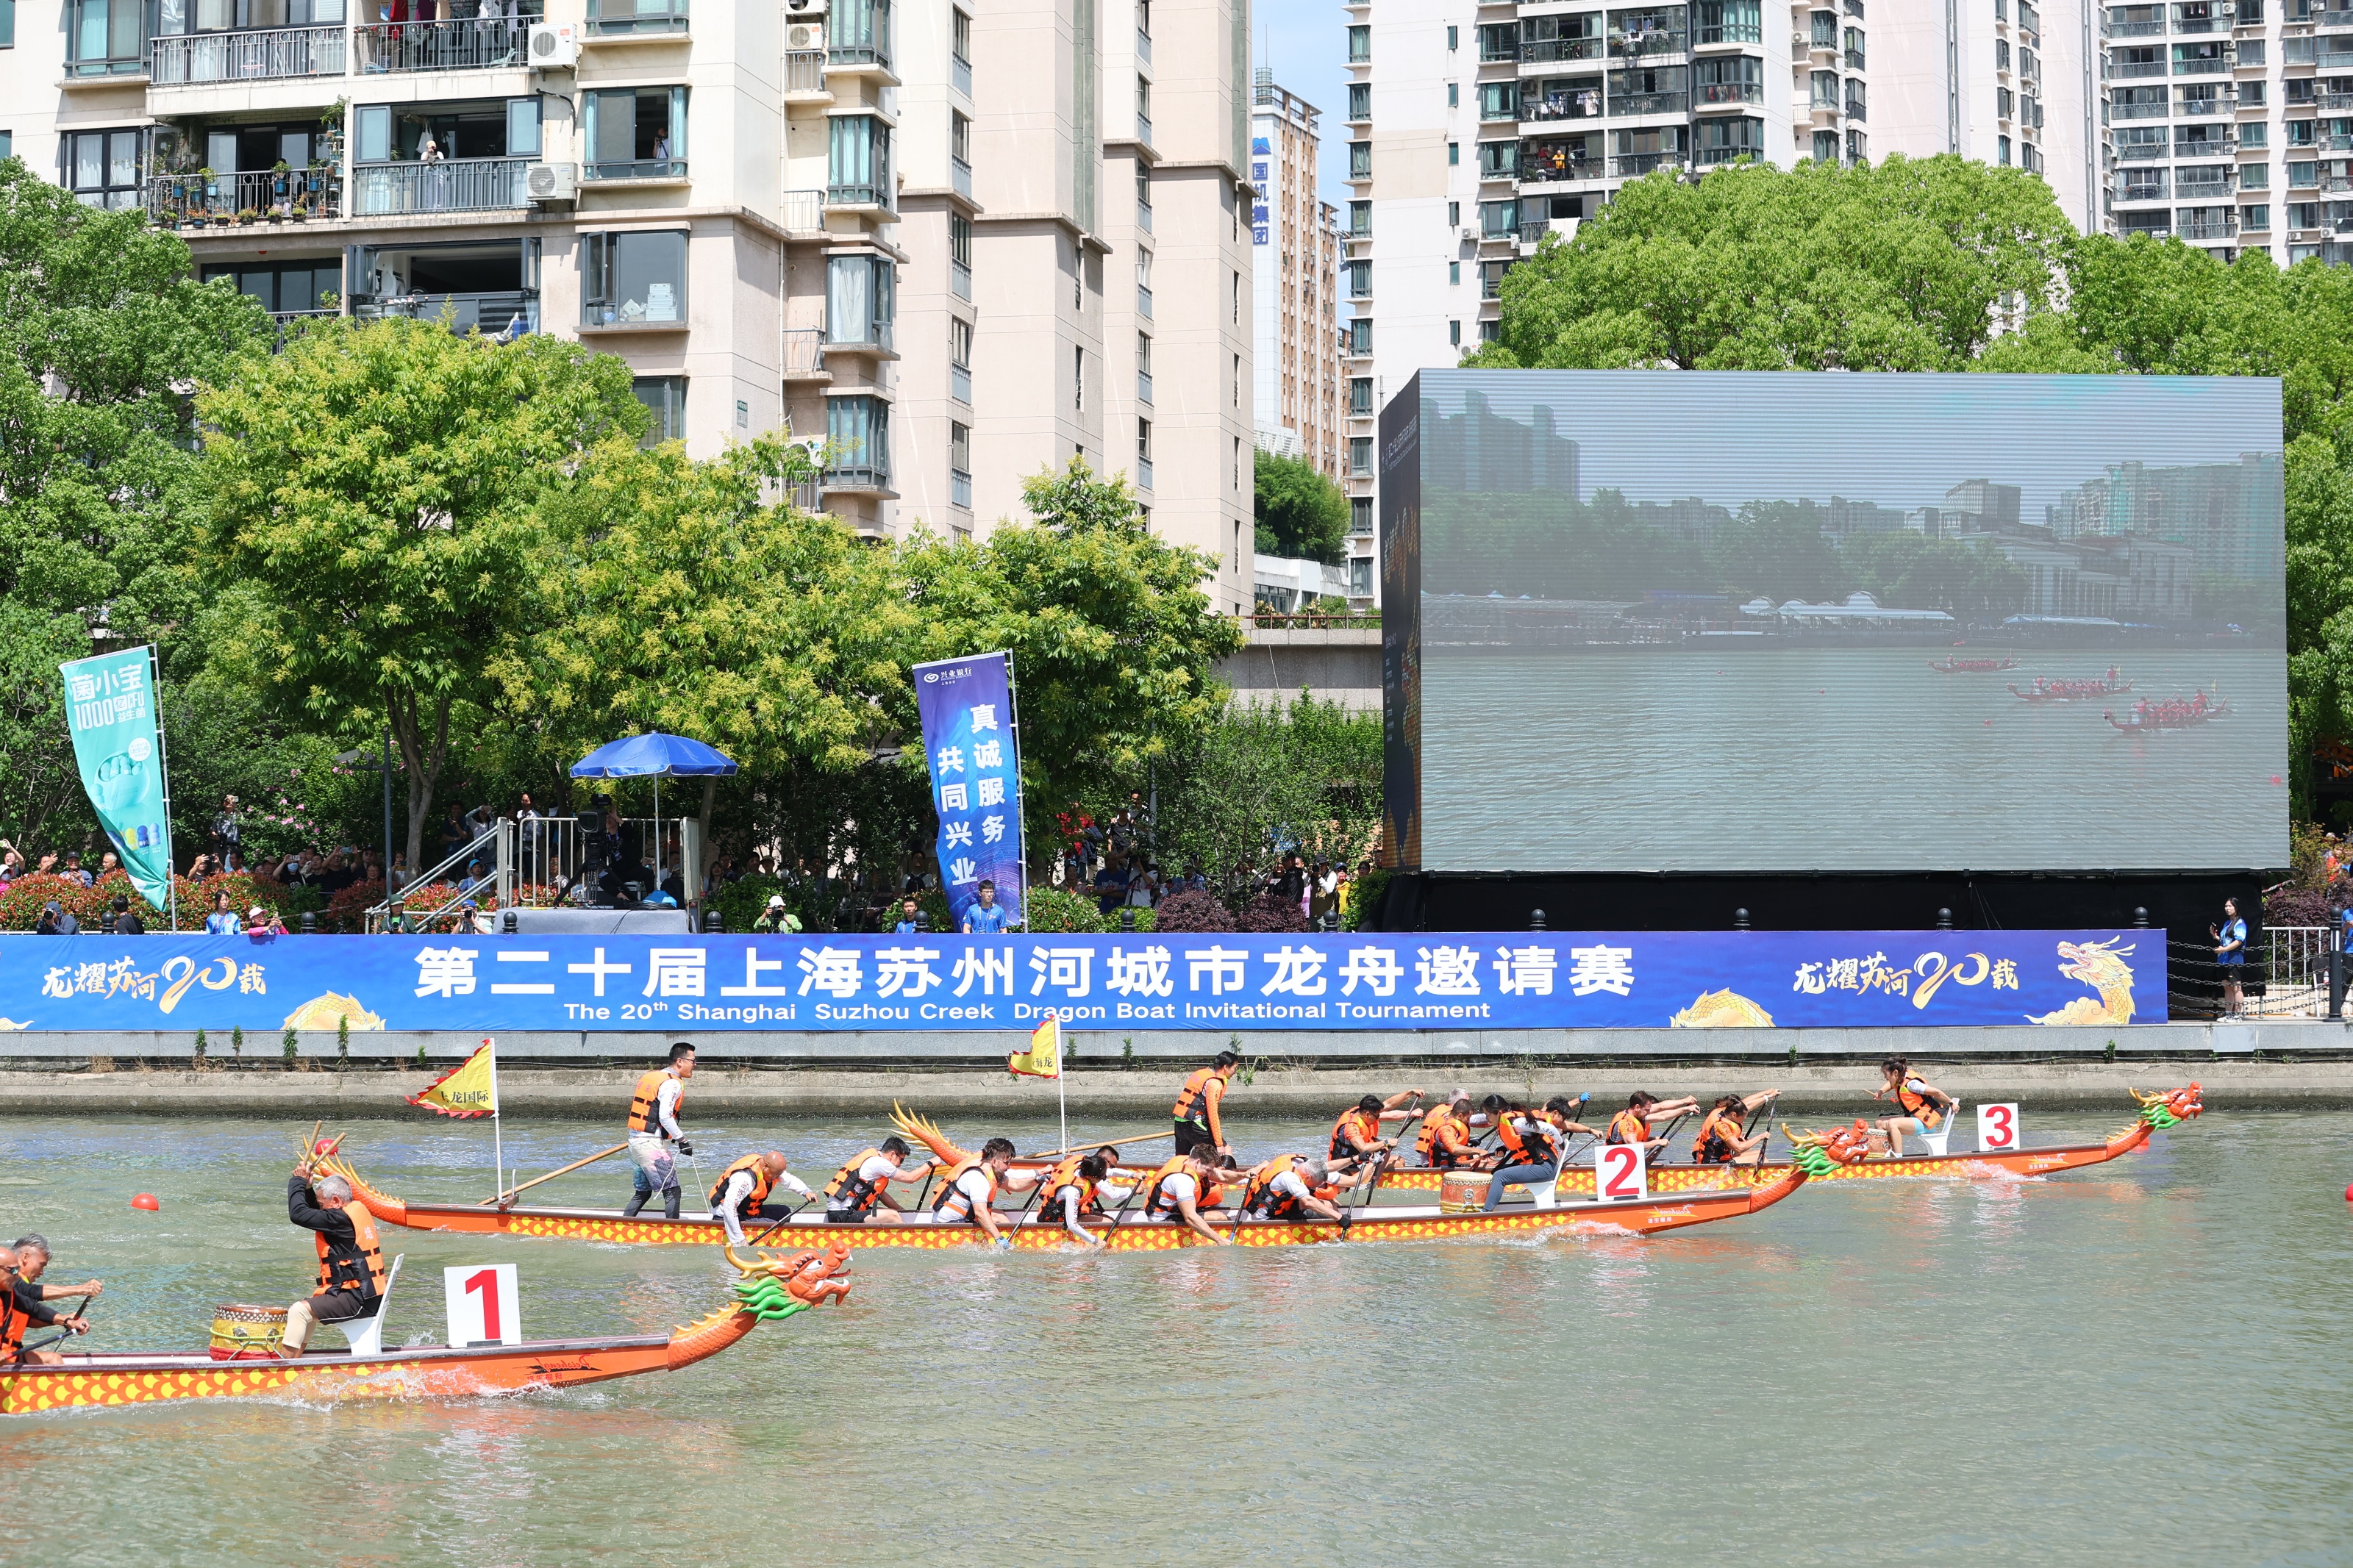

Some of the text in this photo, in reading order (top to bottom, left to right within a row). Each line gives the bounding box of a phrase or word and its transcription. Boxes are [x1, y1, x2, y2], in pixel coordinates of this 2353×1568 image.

[1252, 162, 1269, 245] 国机集团
[69, 664, 143, 702] 菌小宝
[940, 667, 971, 678] 兴业银行
[117, 706, 146, 723] 益生菌
[970, 704, 1006, 845] 真诚服务
[938, 745, 978, 886] 共同兴业
[413, 944, 1635, 998] 第二十届上海苏州河城市龙舟邀请赛
[564, 1003, 610, 1020] The
[677, 1003, 796, 1024] Shanghai
[815, 1003, 910, 1020] Suzhou
[919, 1003, 995, 1020] Creek
[1014, 1003, 1105, 1023] Dragon
[1117, 1003, 1175, 1019] Boat
[1186, 1002, 1326, 1019] Invitational
[1335, 1002, 1490, 1019] Tournament
[1985, 1106, 2013, 1147] 3
[1604, 1148, 1640, 1196] 2
[364, 1226, 374, 1239] 培
[465, 1269, 501, 1340] 1
